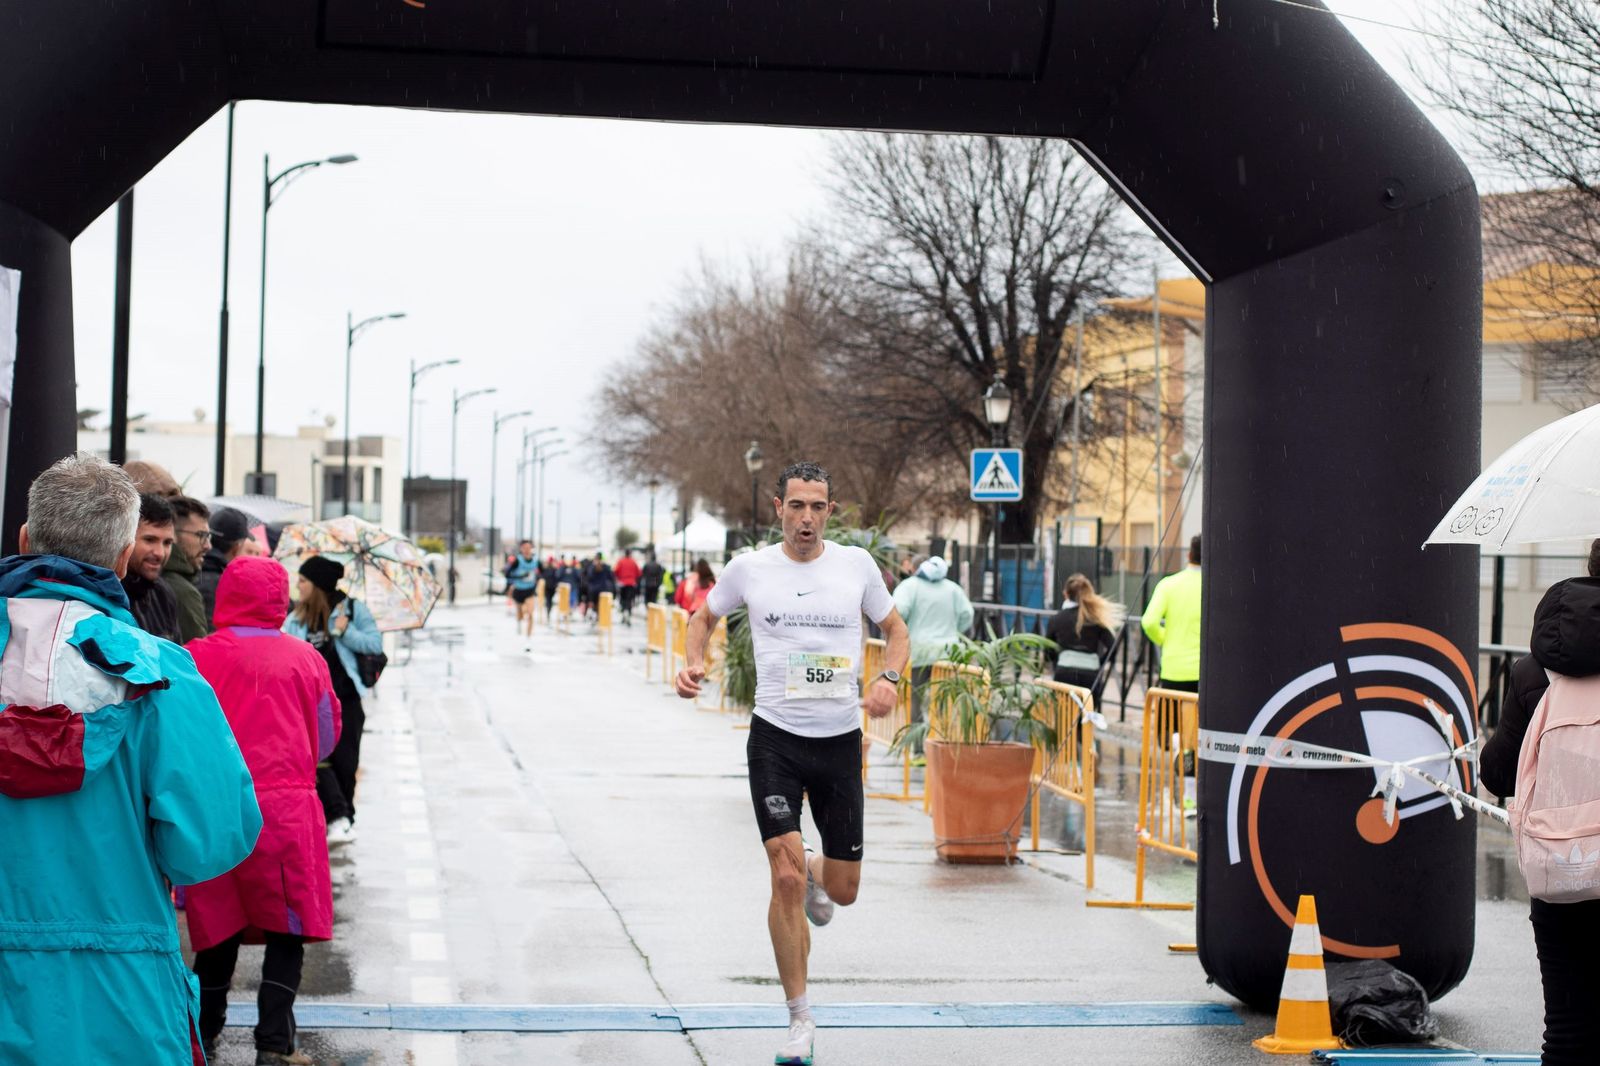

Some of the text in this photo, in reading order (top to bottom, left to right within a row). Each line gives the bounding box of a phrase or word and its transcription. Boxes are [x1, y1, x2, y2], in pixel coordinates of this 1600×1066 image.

[806, 667, 834, 683] 552
[1214, 742, 1240, 753] cruzando
[1246, 746, 1266, 756] meta
[1302, 750, 1343, 762] cruzando
[1554, 879, 1600, 891] adidas
